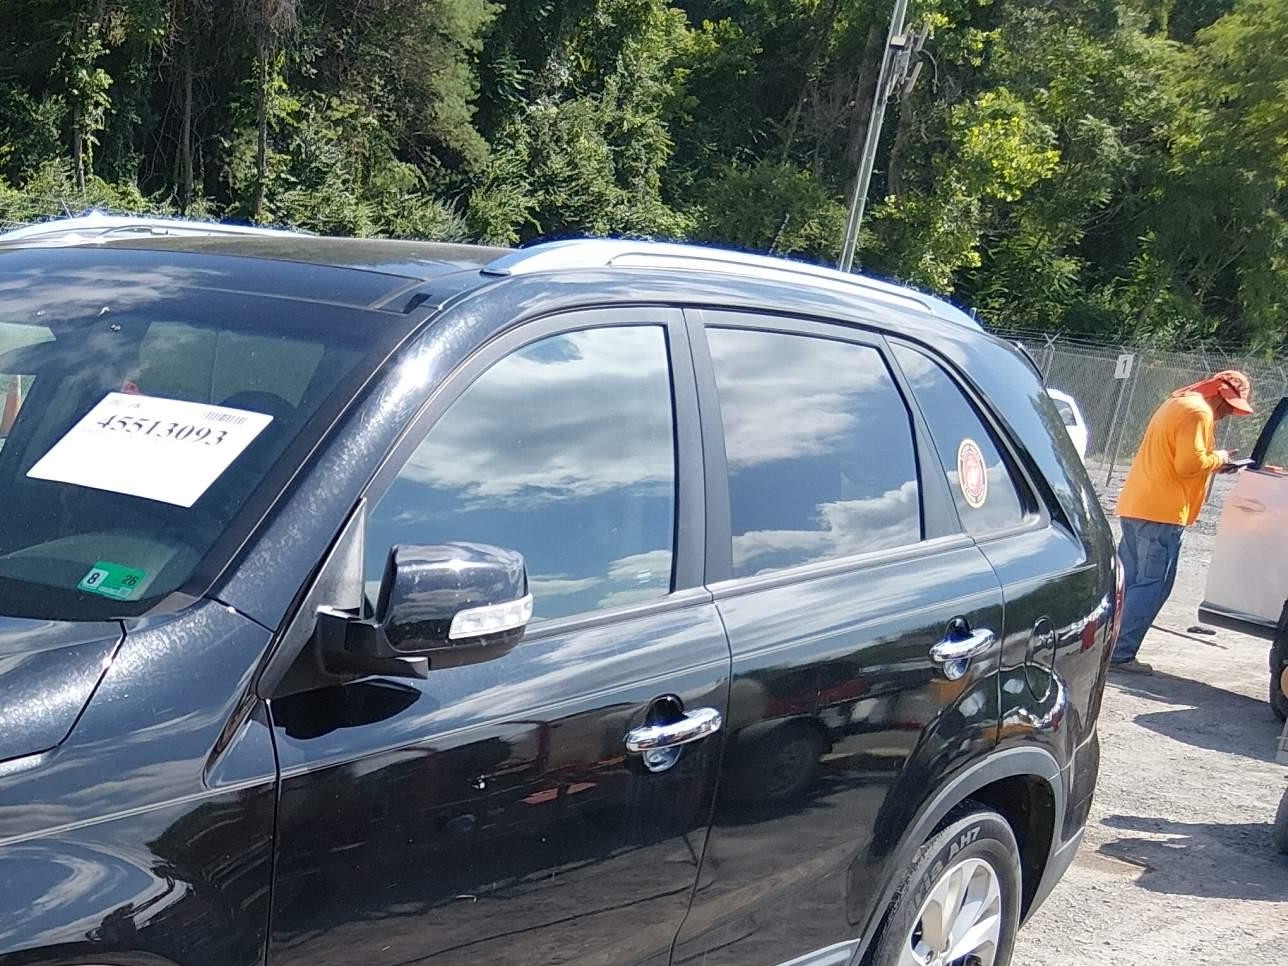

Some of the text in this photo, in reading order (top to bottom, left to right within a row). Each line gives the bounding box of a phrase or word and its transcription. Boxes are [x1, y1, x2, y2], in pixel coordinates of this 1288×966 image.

[97, 414, 229, 446] 45513093
[87, 572, 140, 587] 8 26
[948, 826, 981, 861] AH7
